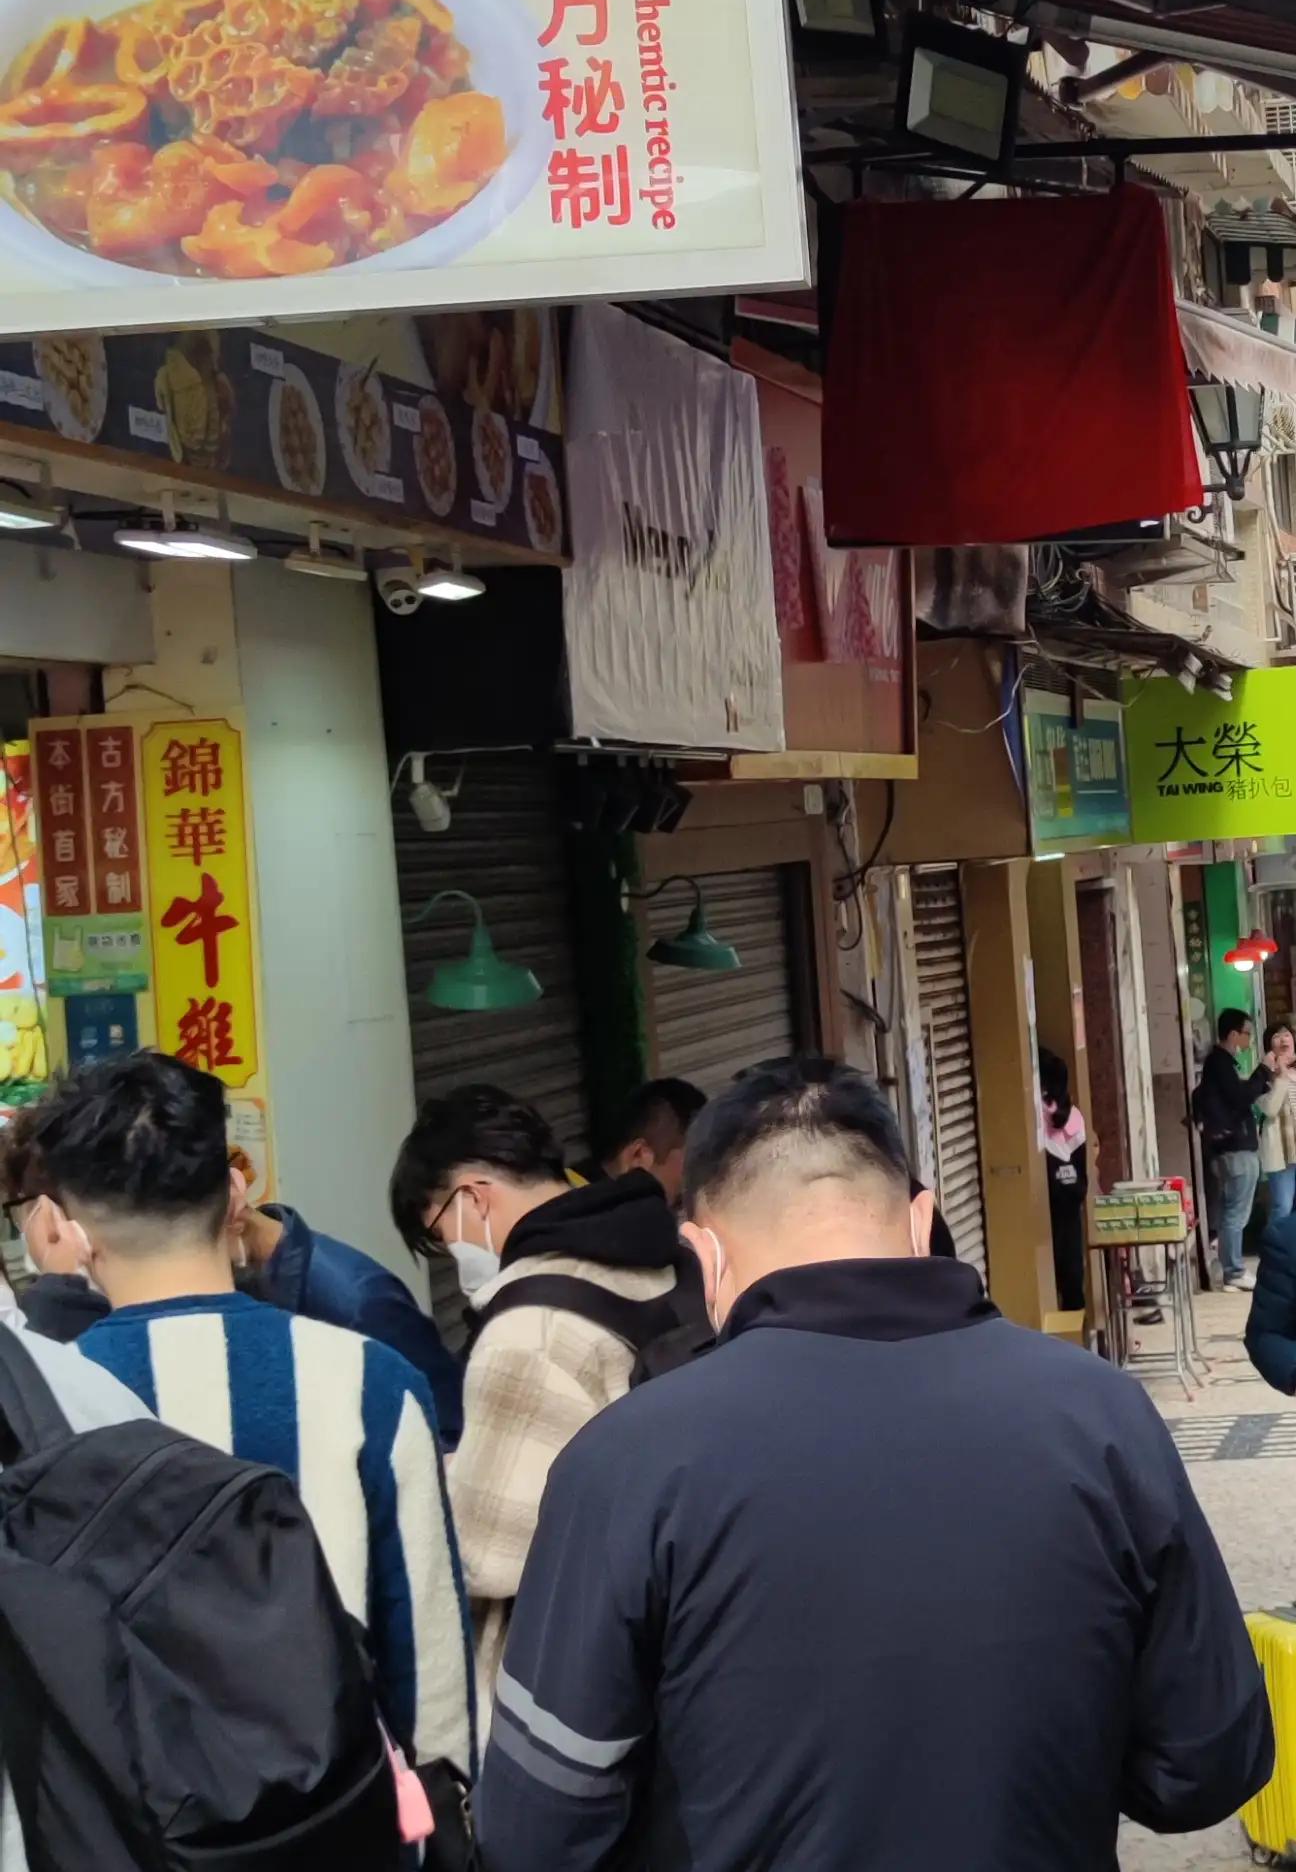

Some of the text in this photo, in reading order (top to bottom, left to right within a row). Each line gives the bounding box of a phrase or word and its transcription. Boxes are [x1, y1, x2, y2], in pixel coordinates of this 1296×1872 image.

[639, 118, 684, 230] recipe
[1155, 721, 1263, 782] 大榮
[1157, 781, 1224, 797] TAI WING
[1225, 776, 1293, 801] 豬扒包
[160, 735, 243, 1073] 錦華牛雜
